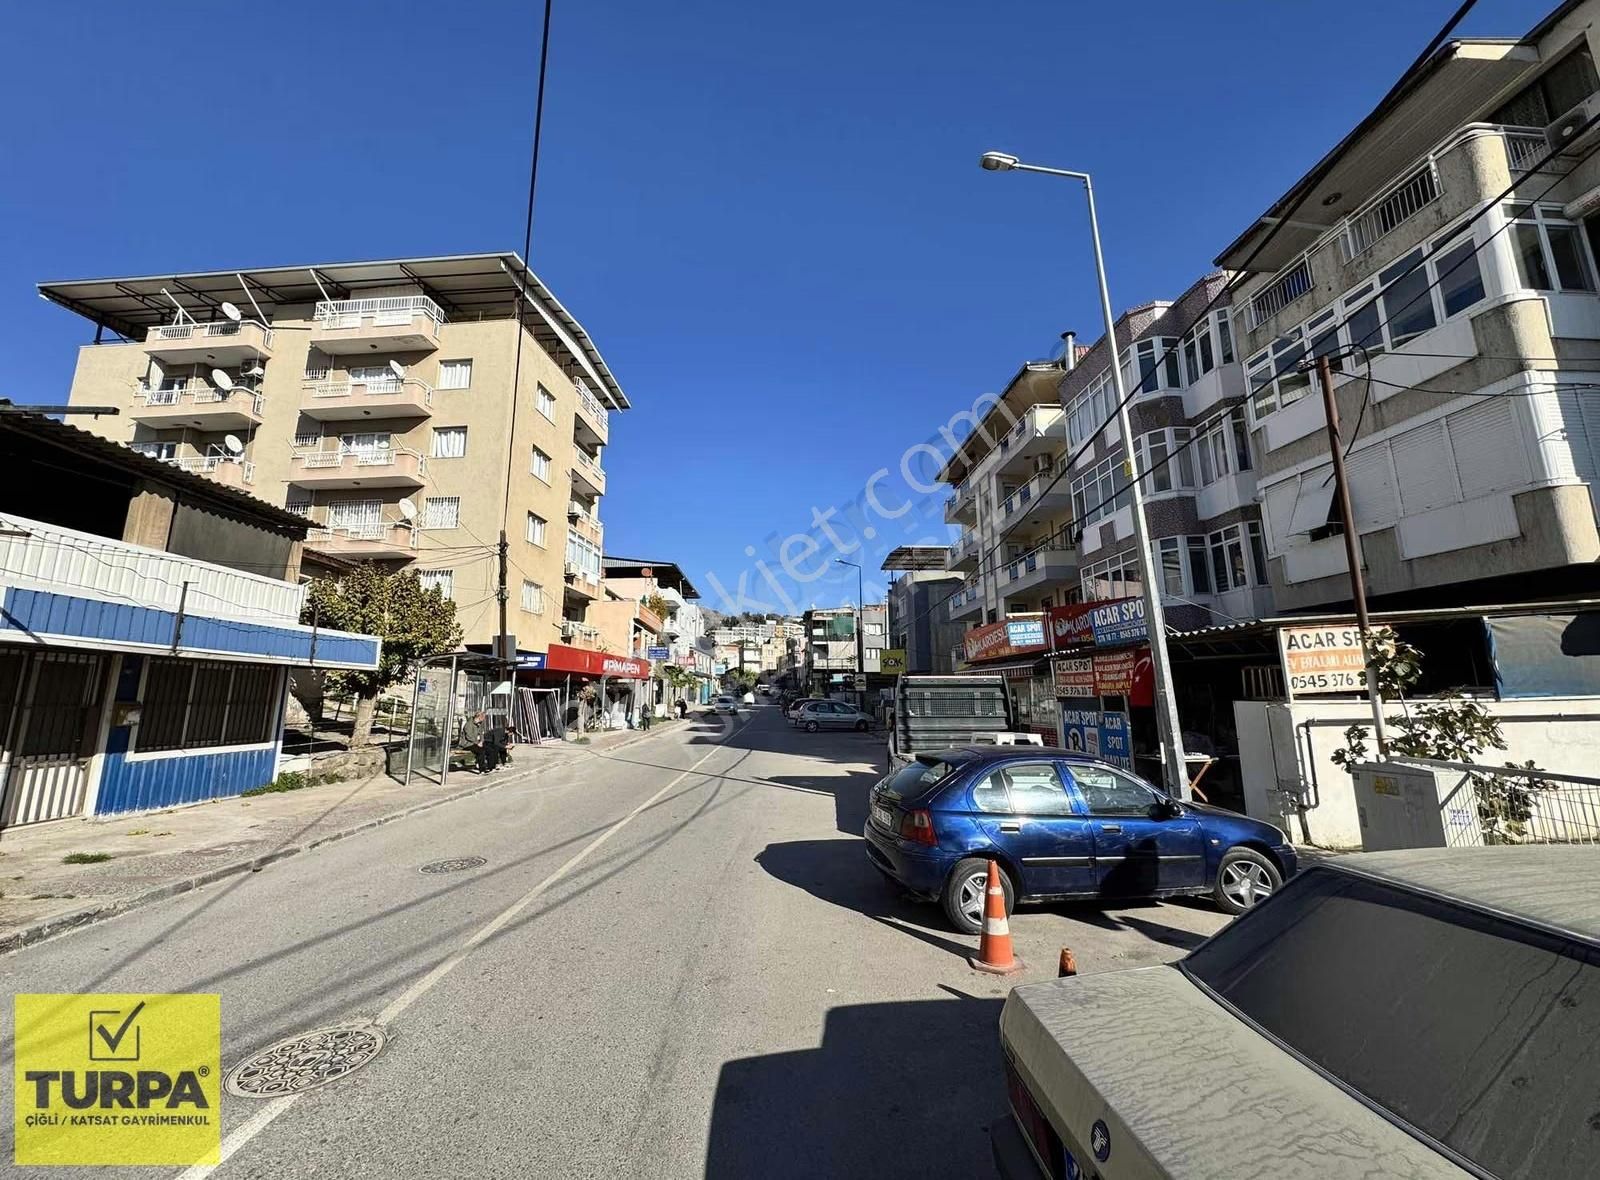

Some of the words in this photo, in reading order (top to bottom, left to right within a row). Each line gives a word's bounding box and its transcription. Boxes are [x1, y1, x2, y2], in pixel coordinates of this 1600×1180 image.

[1094, 606, 1120, 627] ACAR
[1121, 599, 1145, 621] SPO
[1287, 633, 1336, 650] ACAR
[1057, 661, 1073, 672] ACAR
[1074, 660, 1092, 671] SPOT
[1290, 675, 1328, 690] 0545
[1331, 673, 1354, 687] 376
[1064, 711, 1080, 724] ACAR
[1081, 711, 1098, 726] SPOT
[1104, 717, 1122, 730] ACAR
[1107, 735, 1124, 750] SPOT
